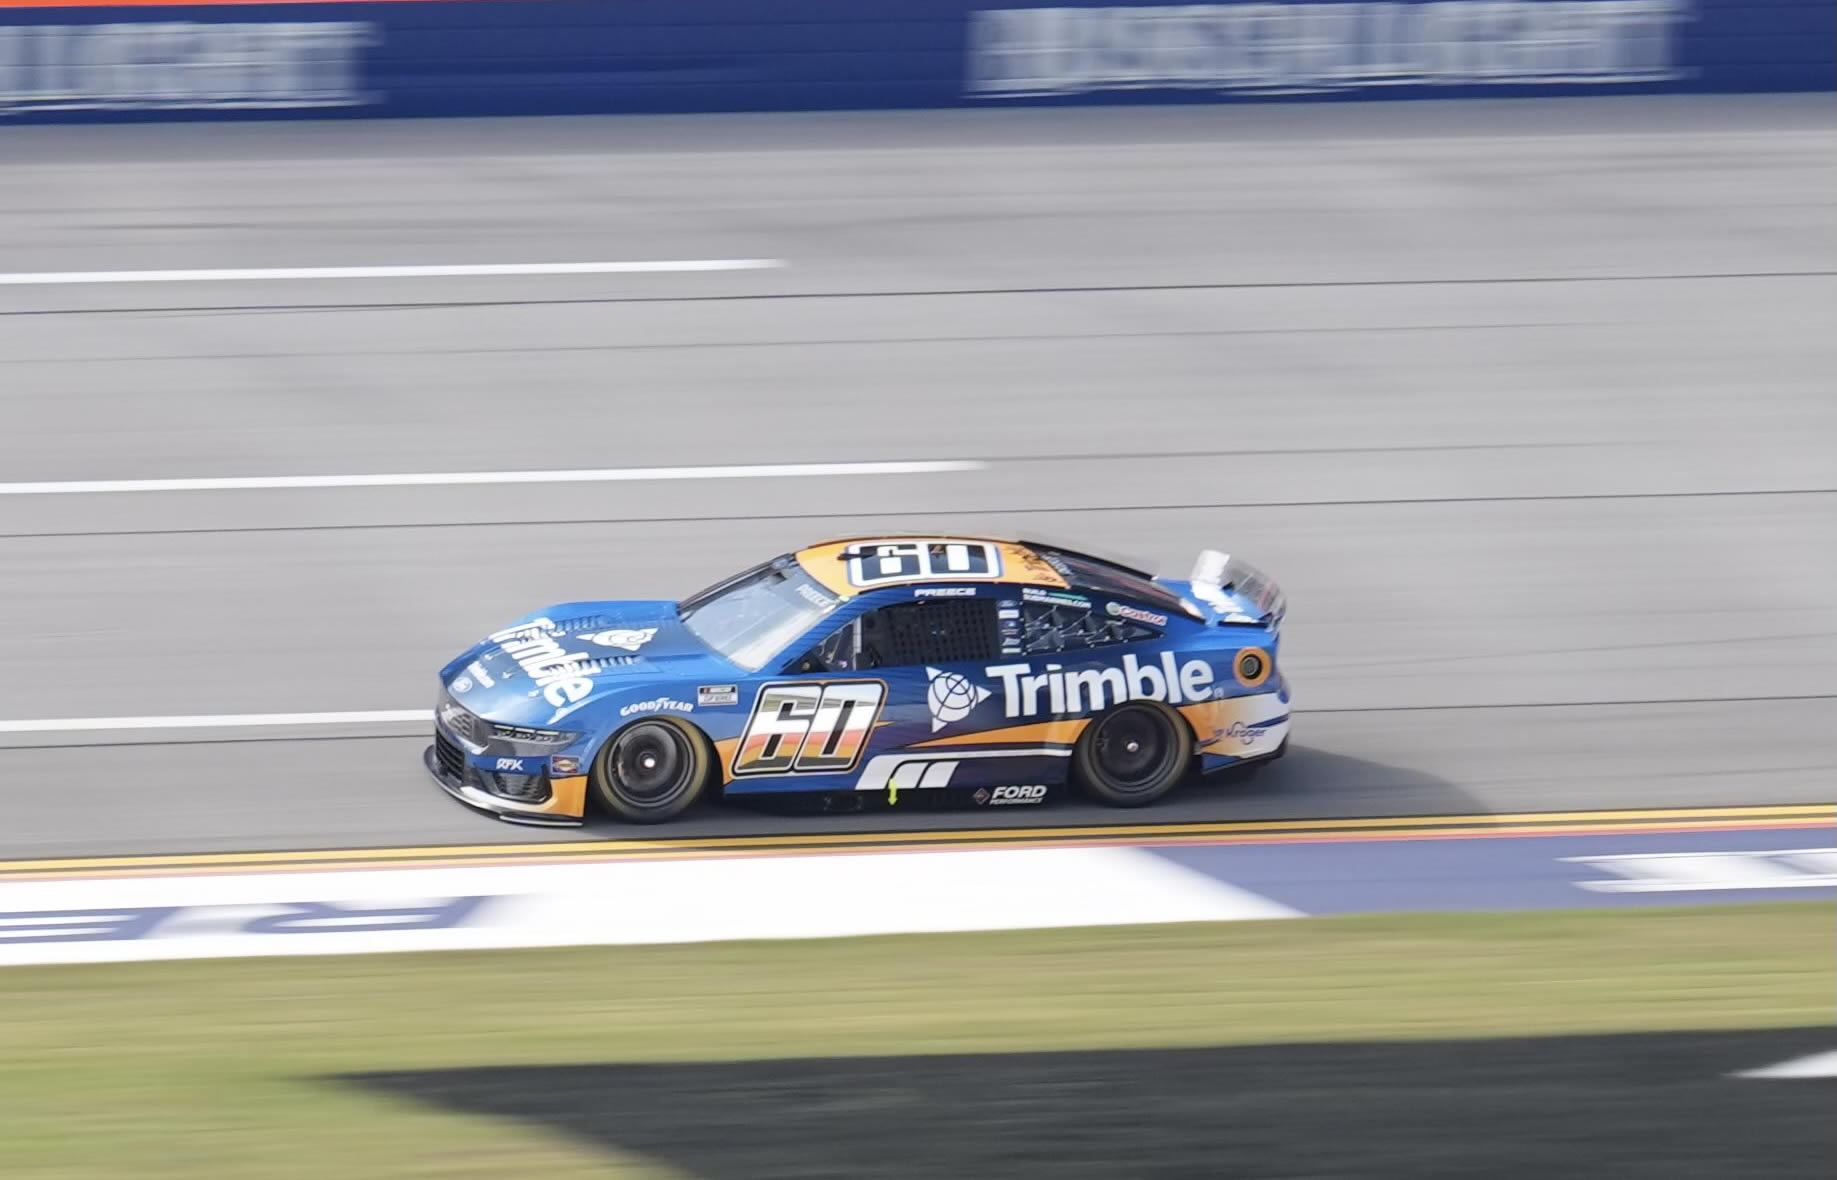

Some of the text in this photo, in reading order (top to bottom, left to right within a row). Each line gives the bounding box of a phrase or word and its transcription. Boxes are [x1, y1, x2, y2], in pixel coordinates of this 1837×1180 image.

[856, 543, 992, 582] 60
[914, 587, 977, 597] PREECE
[985, 651, 1214, 718] Trimble
[620, 697, 694, 717] GOODYEAR
[732, 683, 884, 774] 60
[992, 785, 1048, 798] FORD
